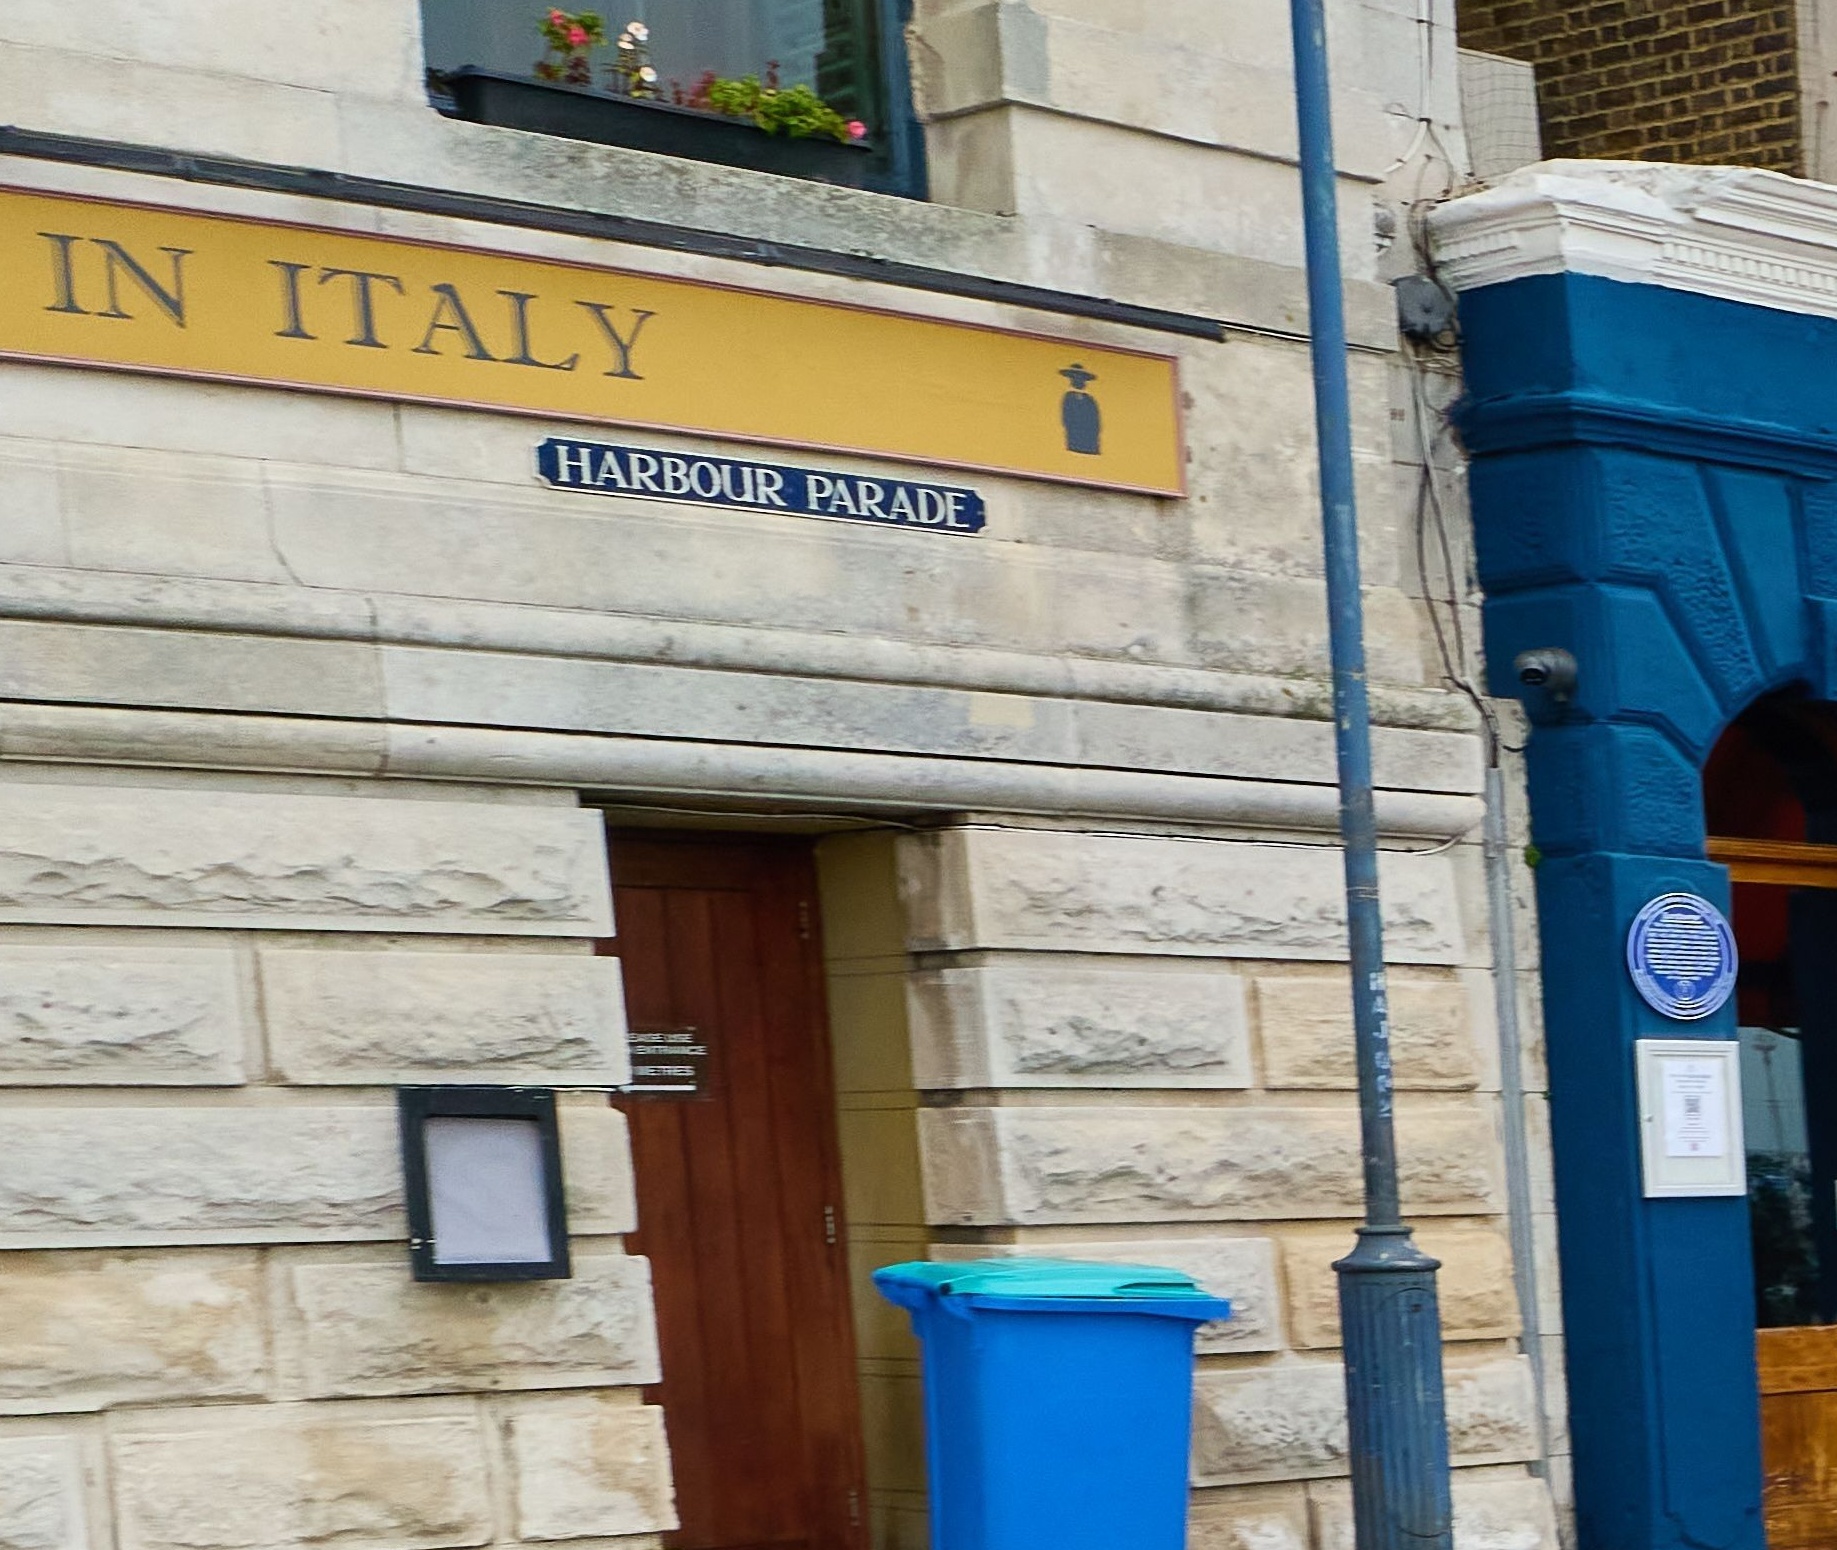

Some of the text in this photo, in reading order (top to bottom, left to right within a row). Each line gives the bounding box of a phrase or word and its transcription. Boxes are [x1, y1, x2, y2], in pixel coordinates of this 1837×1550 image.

[37, 231, 659, 381] IN ITALY
[554, 444, 971, 530] HARBOUR PARADE
